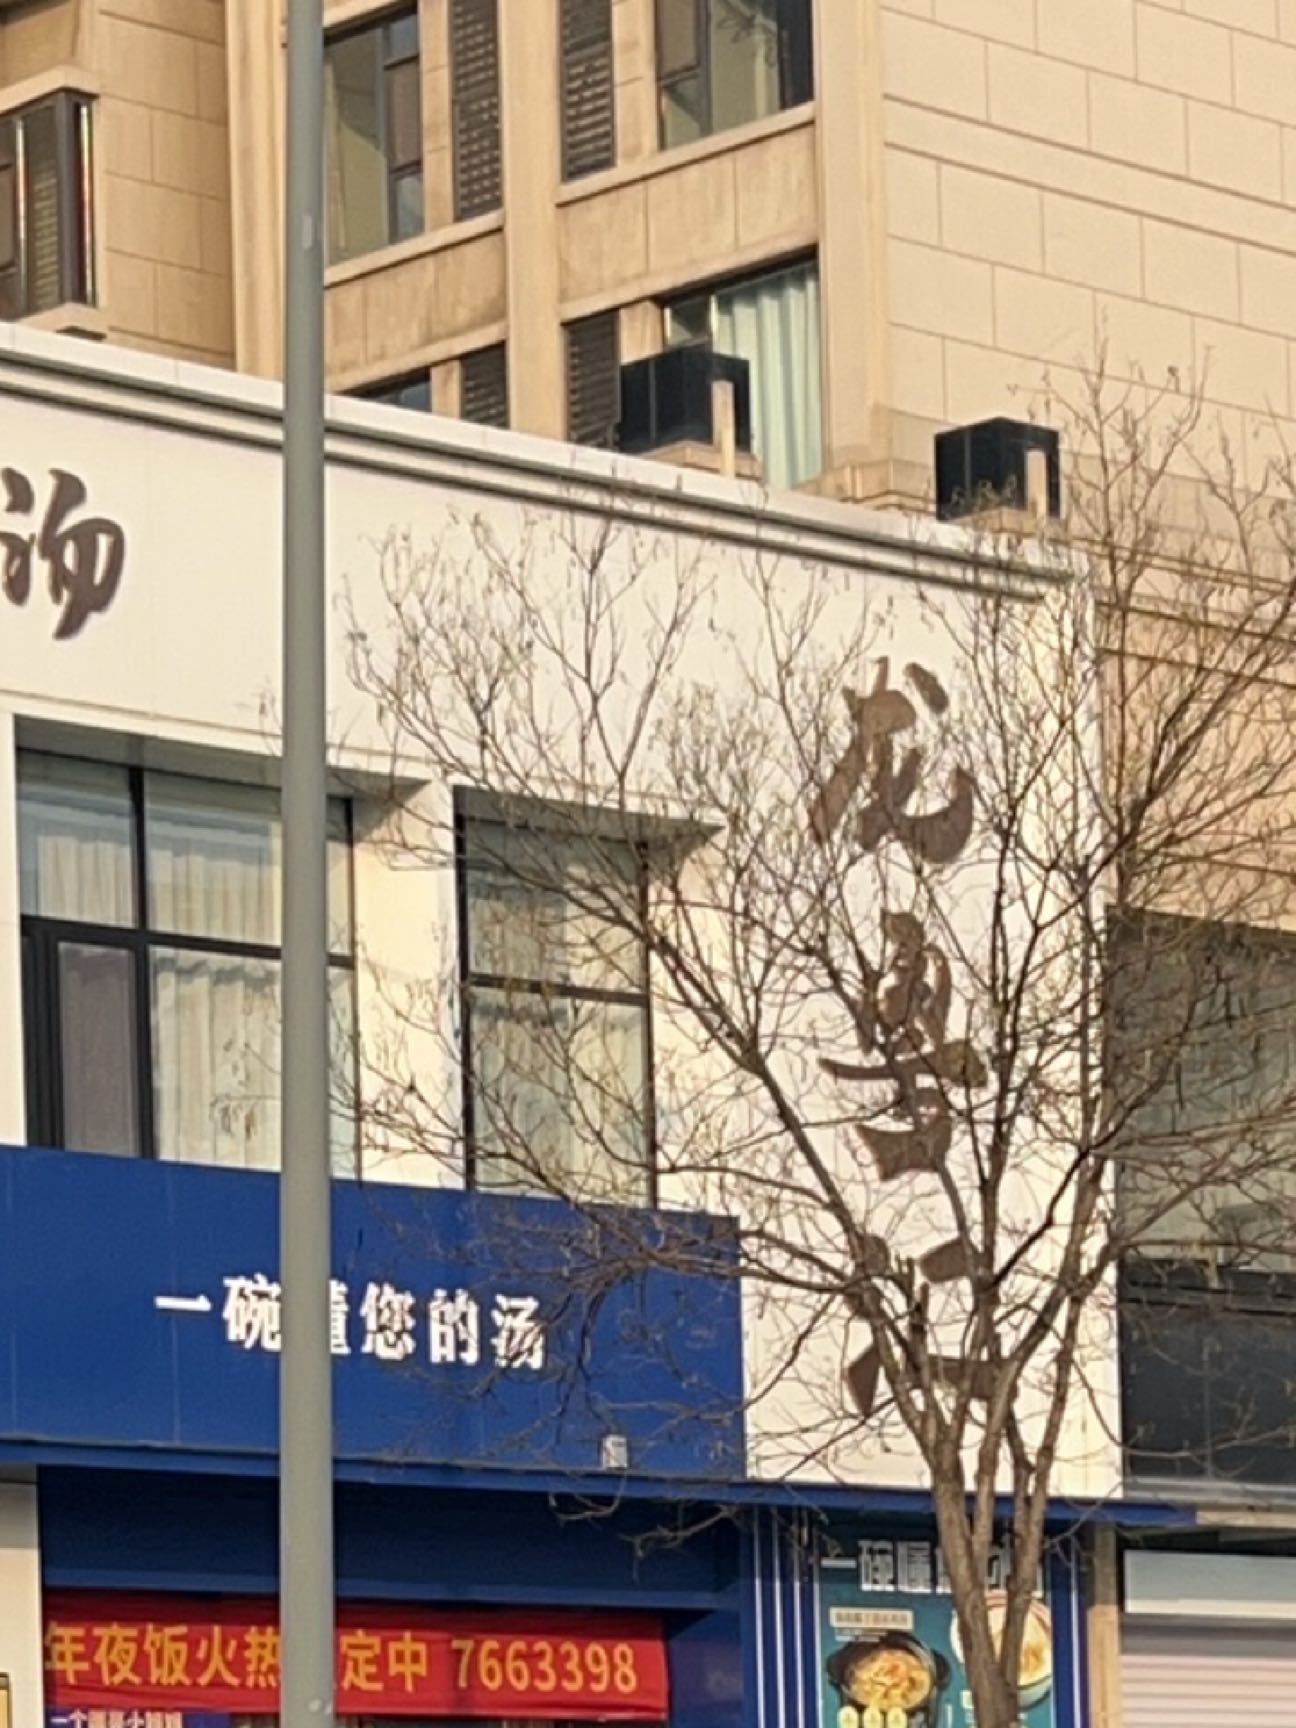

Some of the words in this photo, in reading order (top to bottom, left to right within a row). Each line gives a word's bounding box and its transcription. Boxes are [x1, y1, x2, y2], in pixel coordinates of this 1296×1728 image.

[45, 1620, 427, 1693] 年夜饭火热定中
[451, 1637, 639, 1696] 7663398
